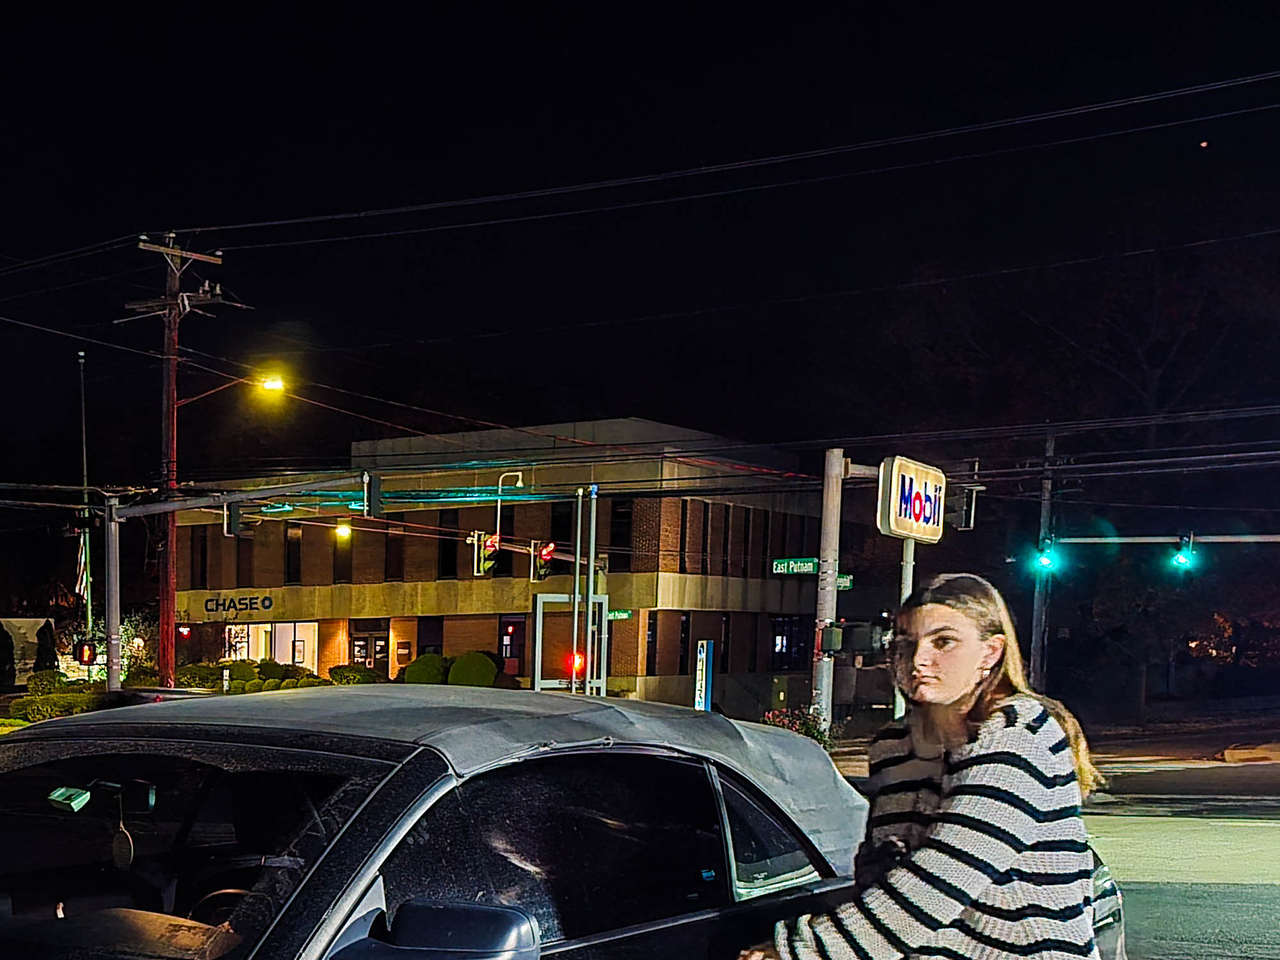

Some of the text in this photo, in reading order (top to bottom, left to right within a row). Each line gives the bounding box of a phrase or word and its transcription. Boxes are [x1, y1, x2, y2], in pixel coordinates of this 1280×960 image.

[898, 473, 942, 527] Mobil
[772, 560, 814, 574] East Putnam
[204, 596, 260, 613] CHASE
